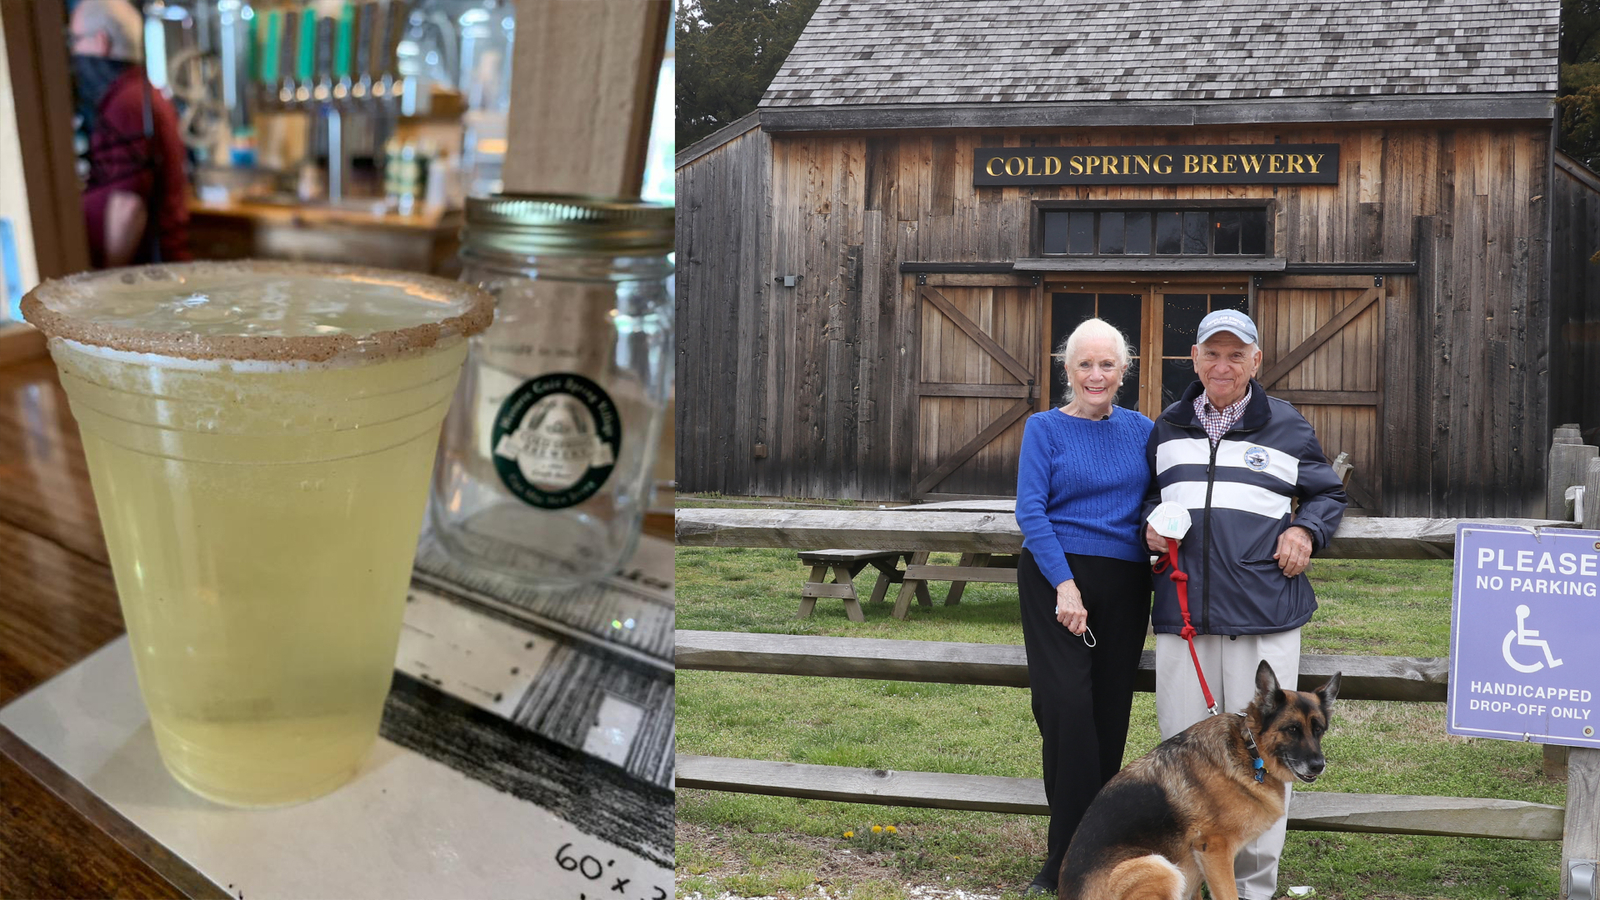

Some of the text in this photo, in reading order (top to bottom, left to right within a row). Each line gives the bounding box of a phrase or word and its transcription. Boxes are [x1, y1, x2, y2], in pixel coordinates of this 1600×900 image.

[985, 153, 1325, 178] COLD SPRING BREWERY
[1477, 547, 1598, 576] PLEASE
[1476, 575, 1597, 597] NO PARKING
[1470, 681, 1592, 702] HANDICAPPED
[1469, 699, 1592, 720] DROP-OFF ONLY
